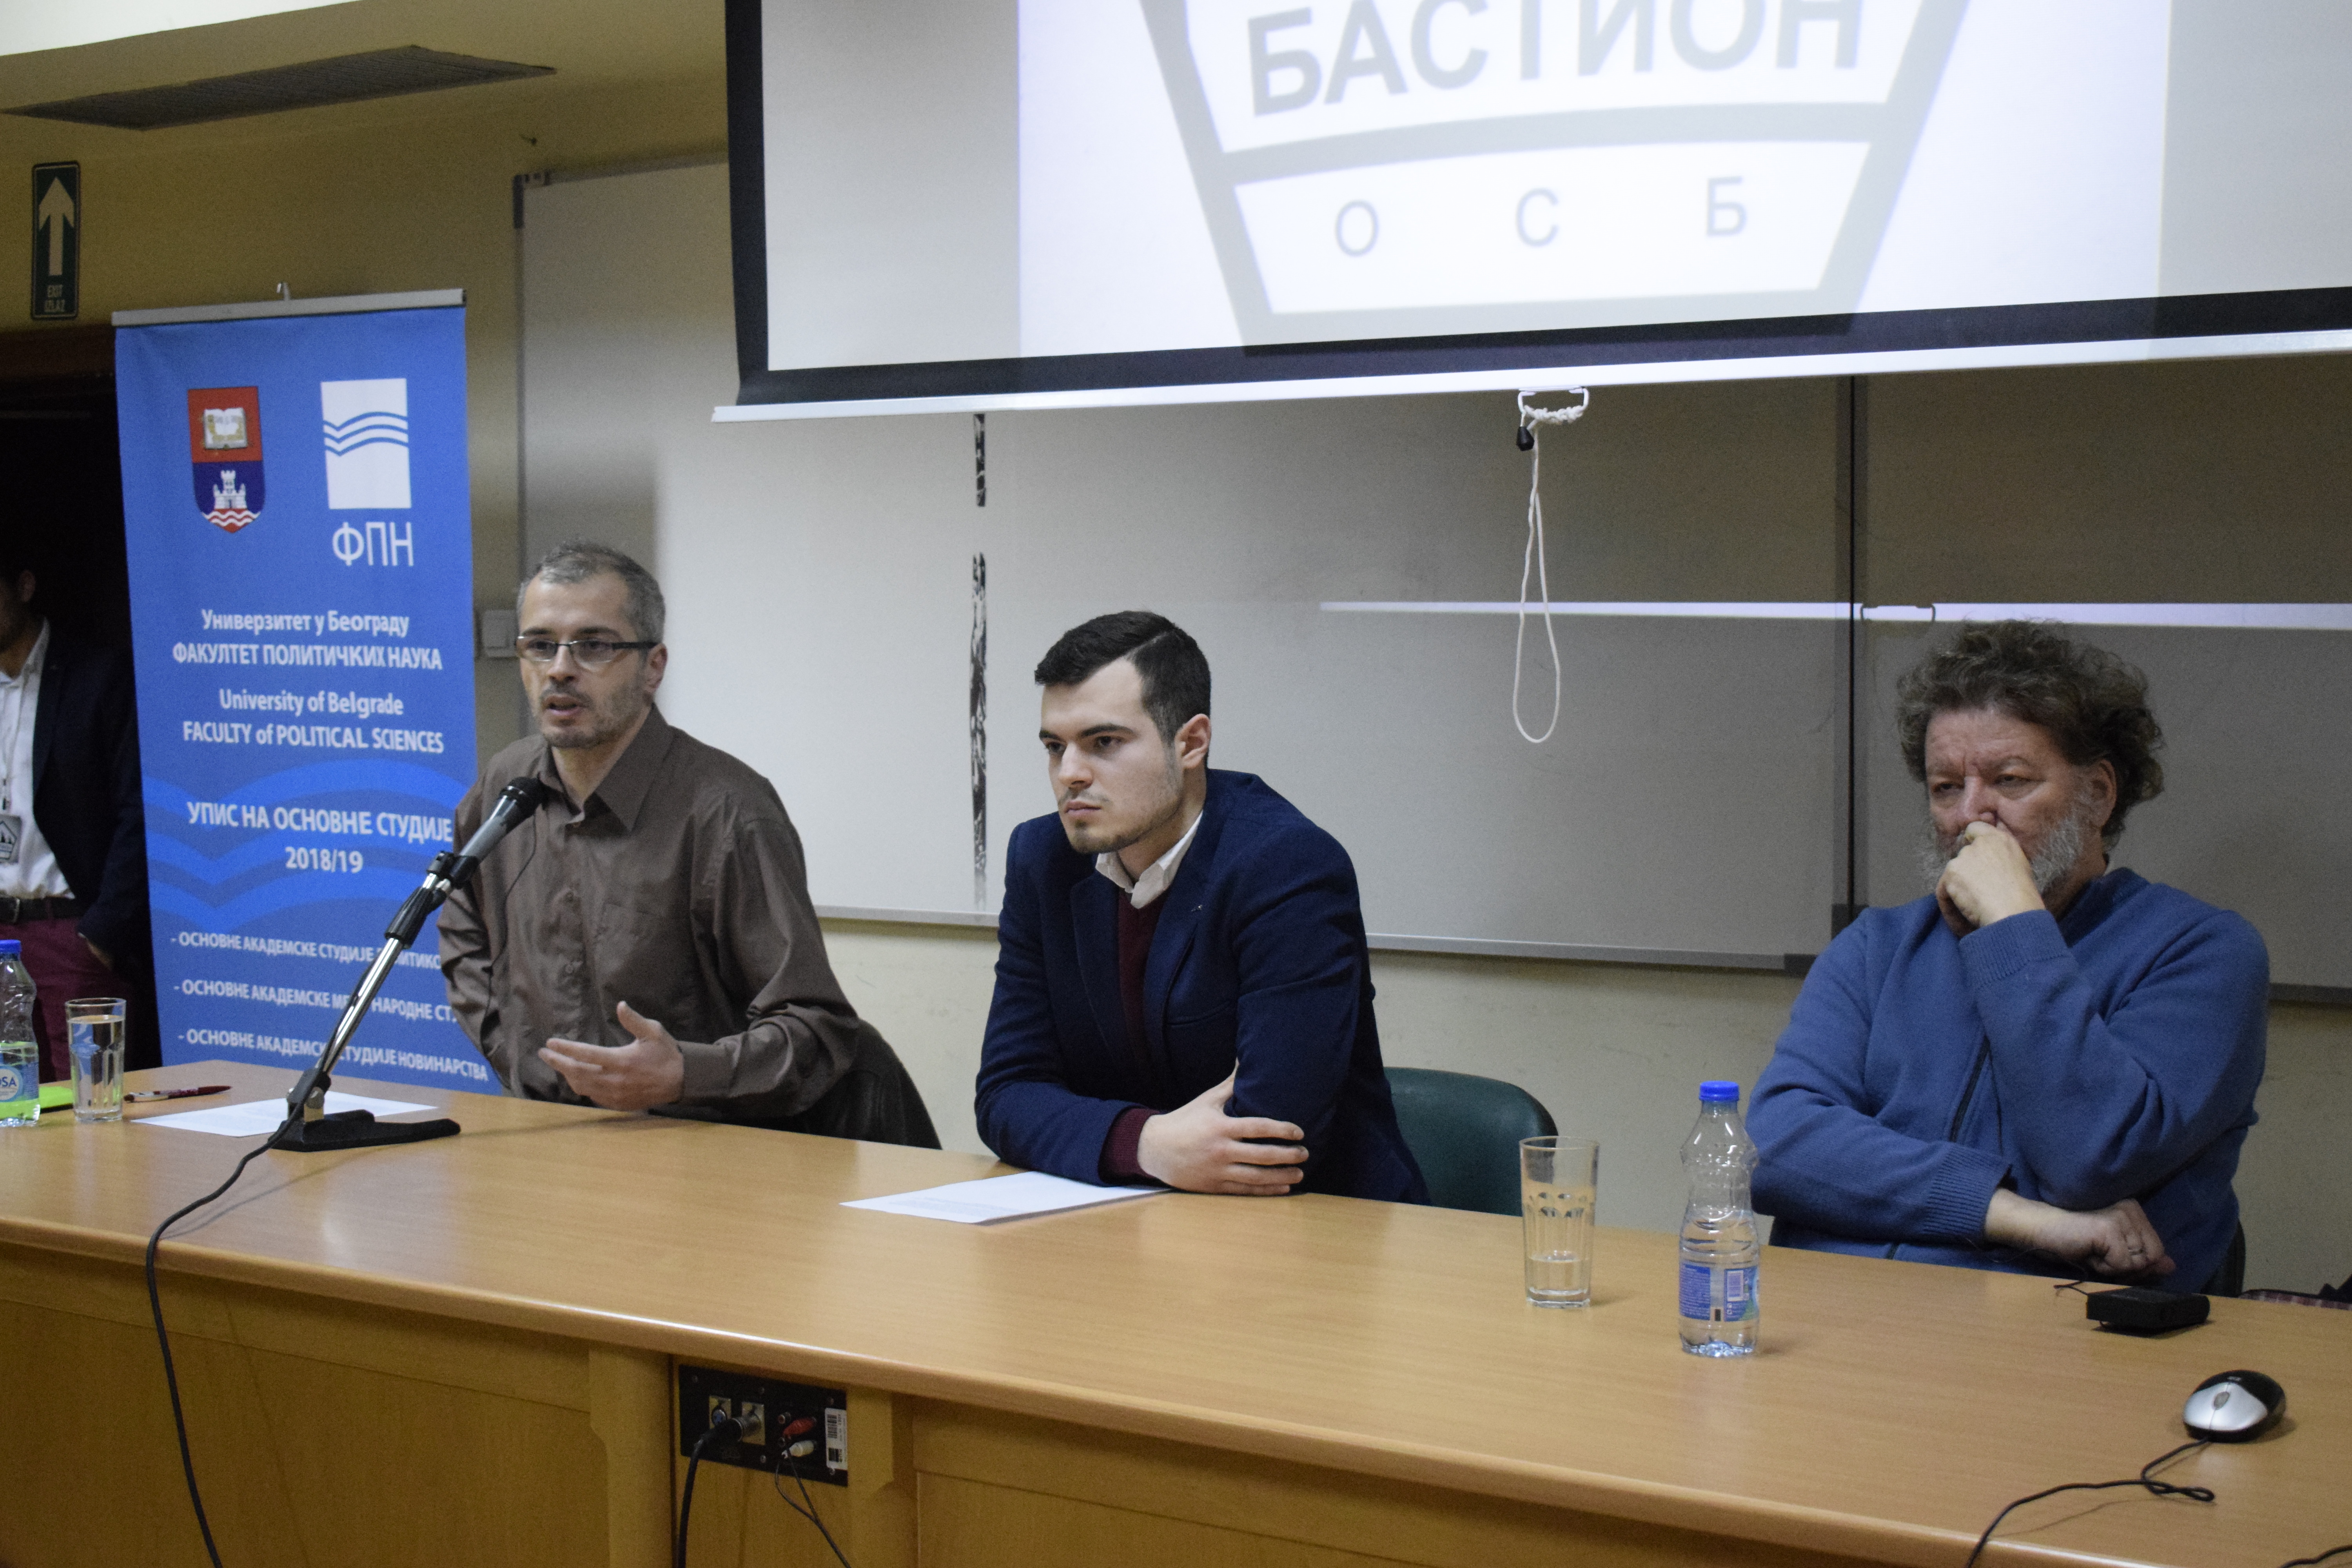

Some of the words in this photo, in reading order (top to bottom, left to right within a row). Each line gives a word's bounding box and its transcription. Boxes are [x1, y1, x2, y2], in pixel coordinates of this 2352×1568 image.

[47, 284, 63, 298] EXIT
[332, 521, 414, 566] ФПН
[201, 608, 312, 636] Универзитет
[314, 615, 325, 637] у
[328, 610, 410, 638] Београду
[172, 642, 260, 665] ФАКУЛТЕТ
[263, 644, 387, 667] ПОЛИТИЧКИХ
[387, 646, 443, 670] НАУКА
[219, 688, 304, 717] University
[307, 690, 325, 712] of
[327, 691, 404, 719] Belgrade
[183, 720, 252, 744] FACULTY
[256, 723, 274, 745] of
[276, 724, 369, 748] POLITICAL
[372, 727, 445, 754] SCIENCES
[186, 801, 239, 827] УПИС
[241, 804, 270, 829] НА
[273, 806, 373, 835] ОСНОВНЕ
[376, 812, 453, 845] СТУДИЈЕ
[285, 846, 364, 874] 2018/19
[178, 931, 242, 950] ОСНОВНЕ
[242, 935, 318, 957] АКАДЕМСКЕ
[318, 943, 374, 964] СТУДИЈЕ
[181, 978, 250, 1000] ОСНОВНЕ
[251, 984, 331, 1008] АКАДЕМСКЕ
[332, 993, 433, 1021] МЕНАРОДНЕ
[434, 1004, 457, 1023] СТ
[187, 1028, 254, 1049] ОСНОВНЕ
[339, 1045, 397, 1066] ТУДИЈЕ
[397, 1050, 489, 1081] НОВИНАРСТВА
